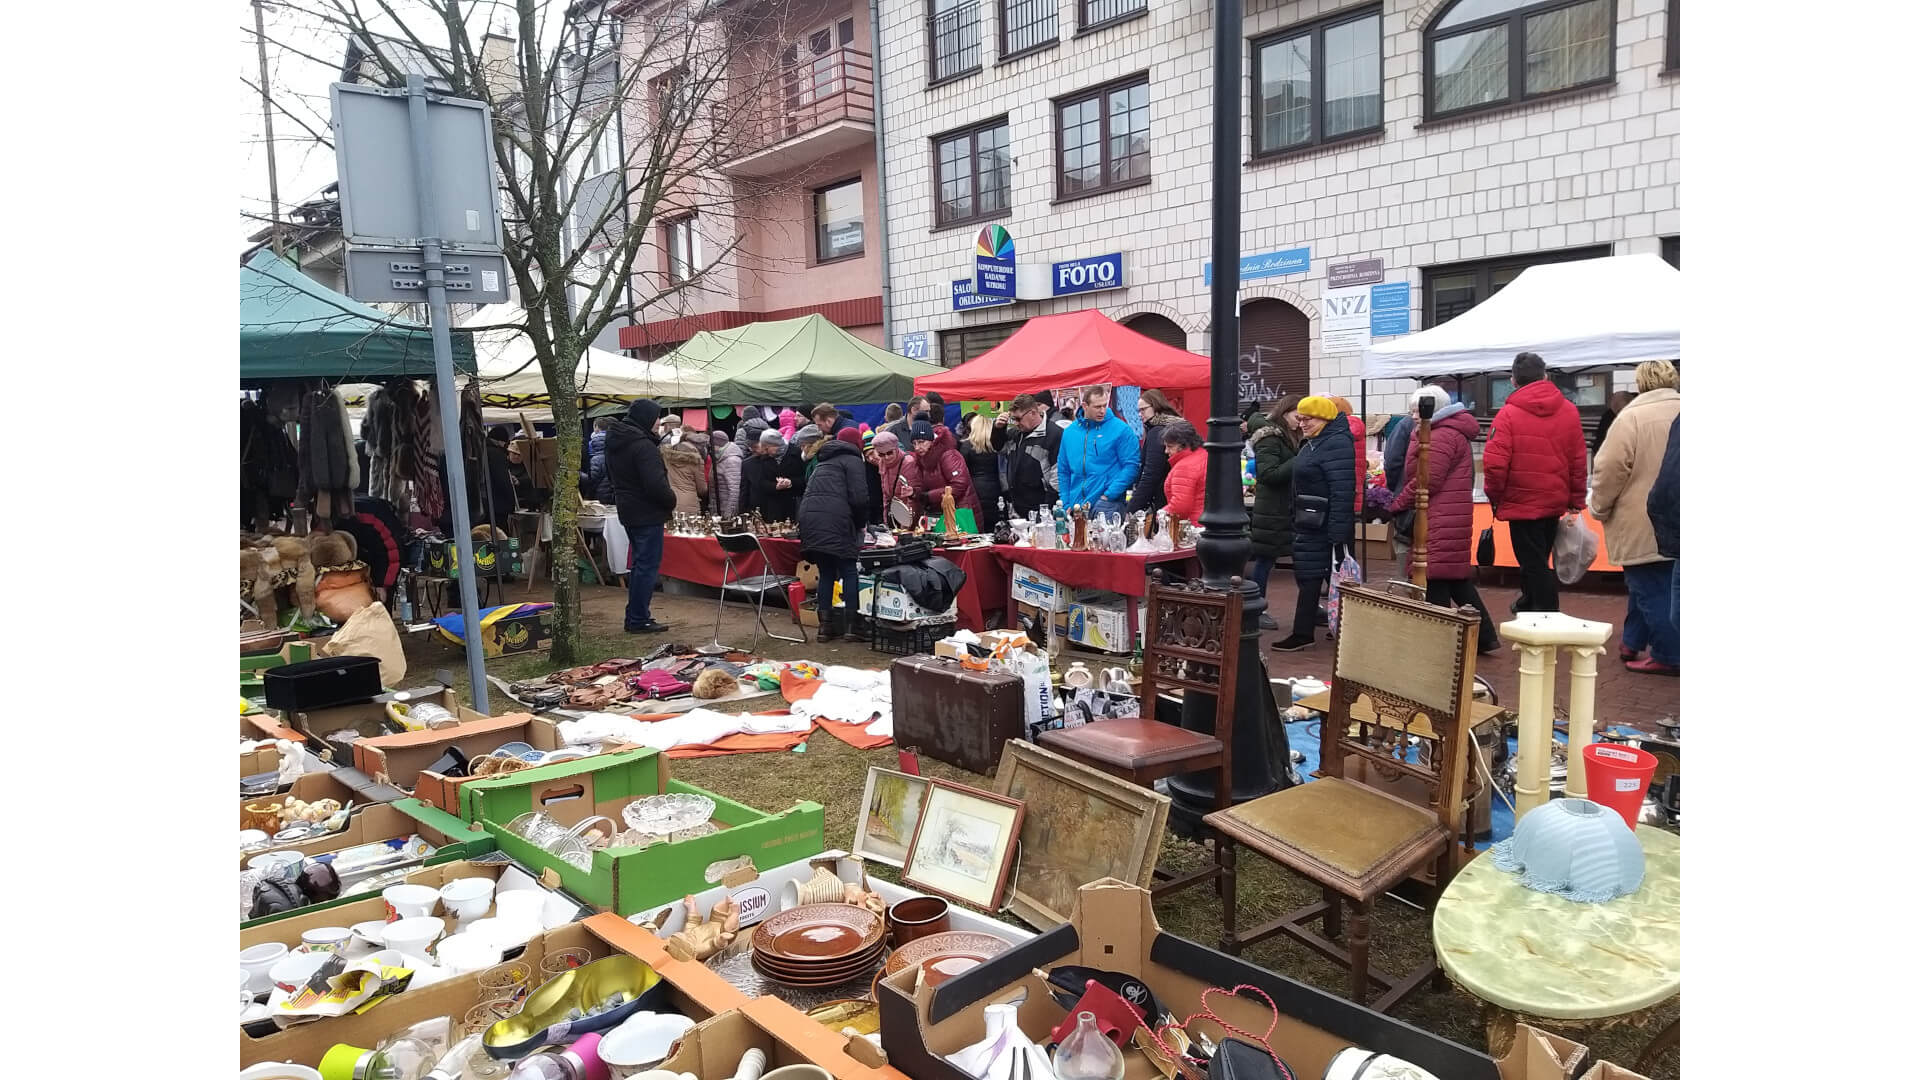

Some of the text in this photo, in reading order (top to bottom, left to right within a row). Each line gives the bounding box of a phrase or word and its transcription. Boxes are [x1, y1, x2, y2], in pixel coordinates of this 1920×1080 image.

[1058, 261, 1115, 288] FOTO
[954, 282, 971, 295] SALO
[907, 340, 924, 357] 27
